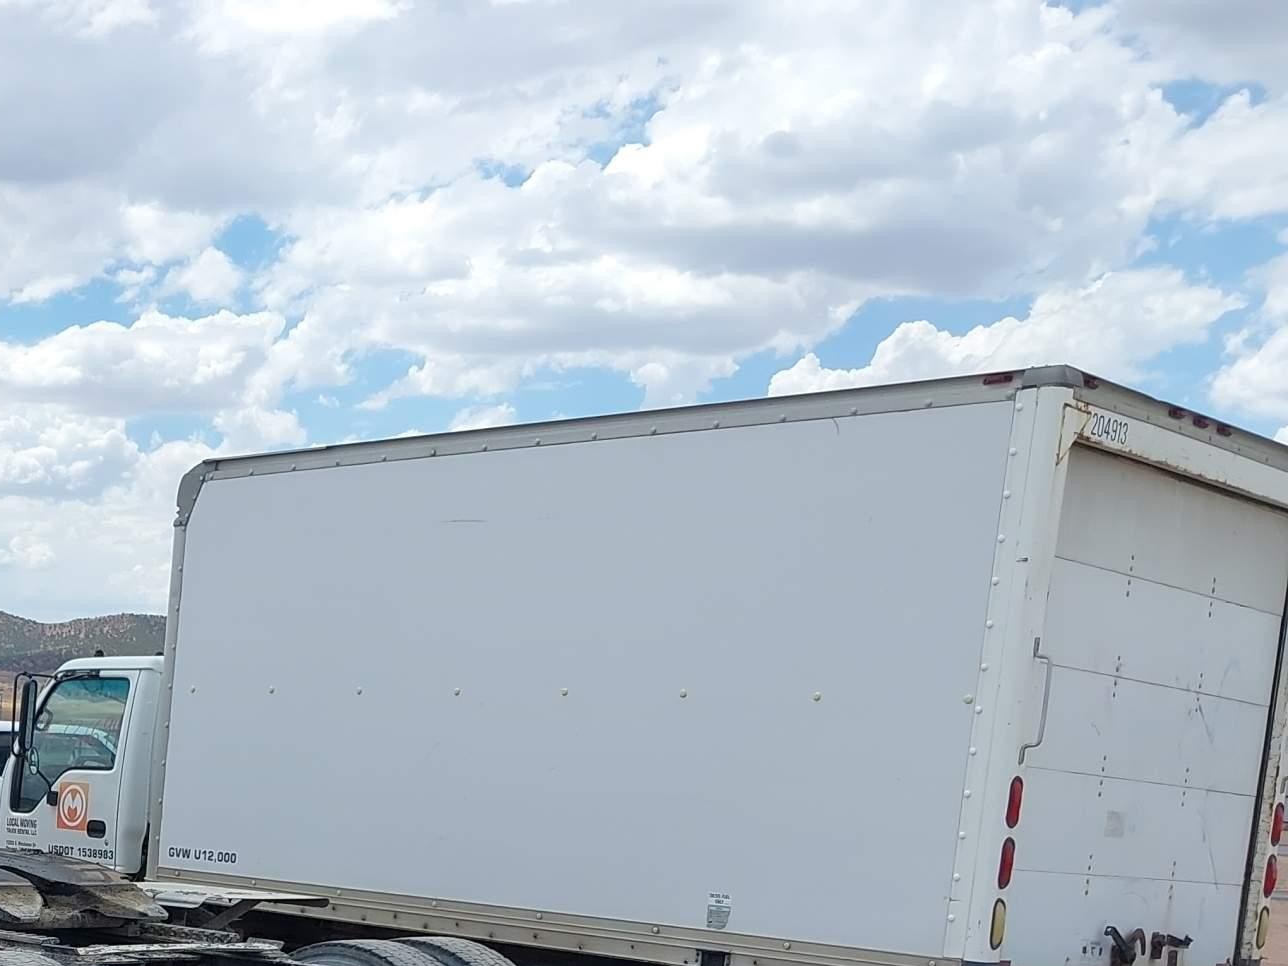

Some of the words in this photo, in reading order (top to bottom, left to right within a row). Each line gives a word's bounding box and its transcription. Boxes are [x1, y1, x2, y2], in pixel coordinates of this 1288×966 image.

[1091, 413, 1128, 445] 204913
[48, 844, 74, 856] USDOT
[168, 847, 191, 859] GVW
[194, 849, 237, 864] U12,000
